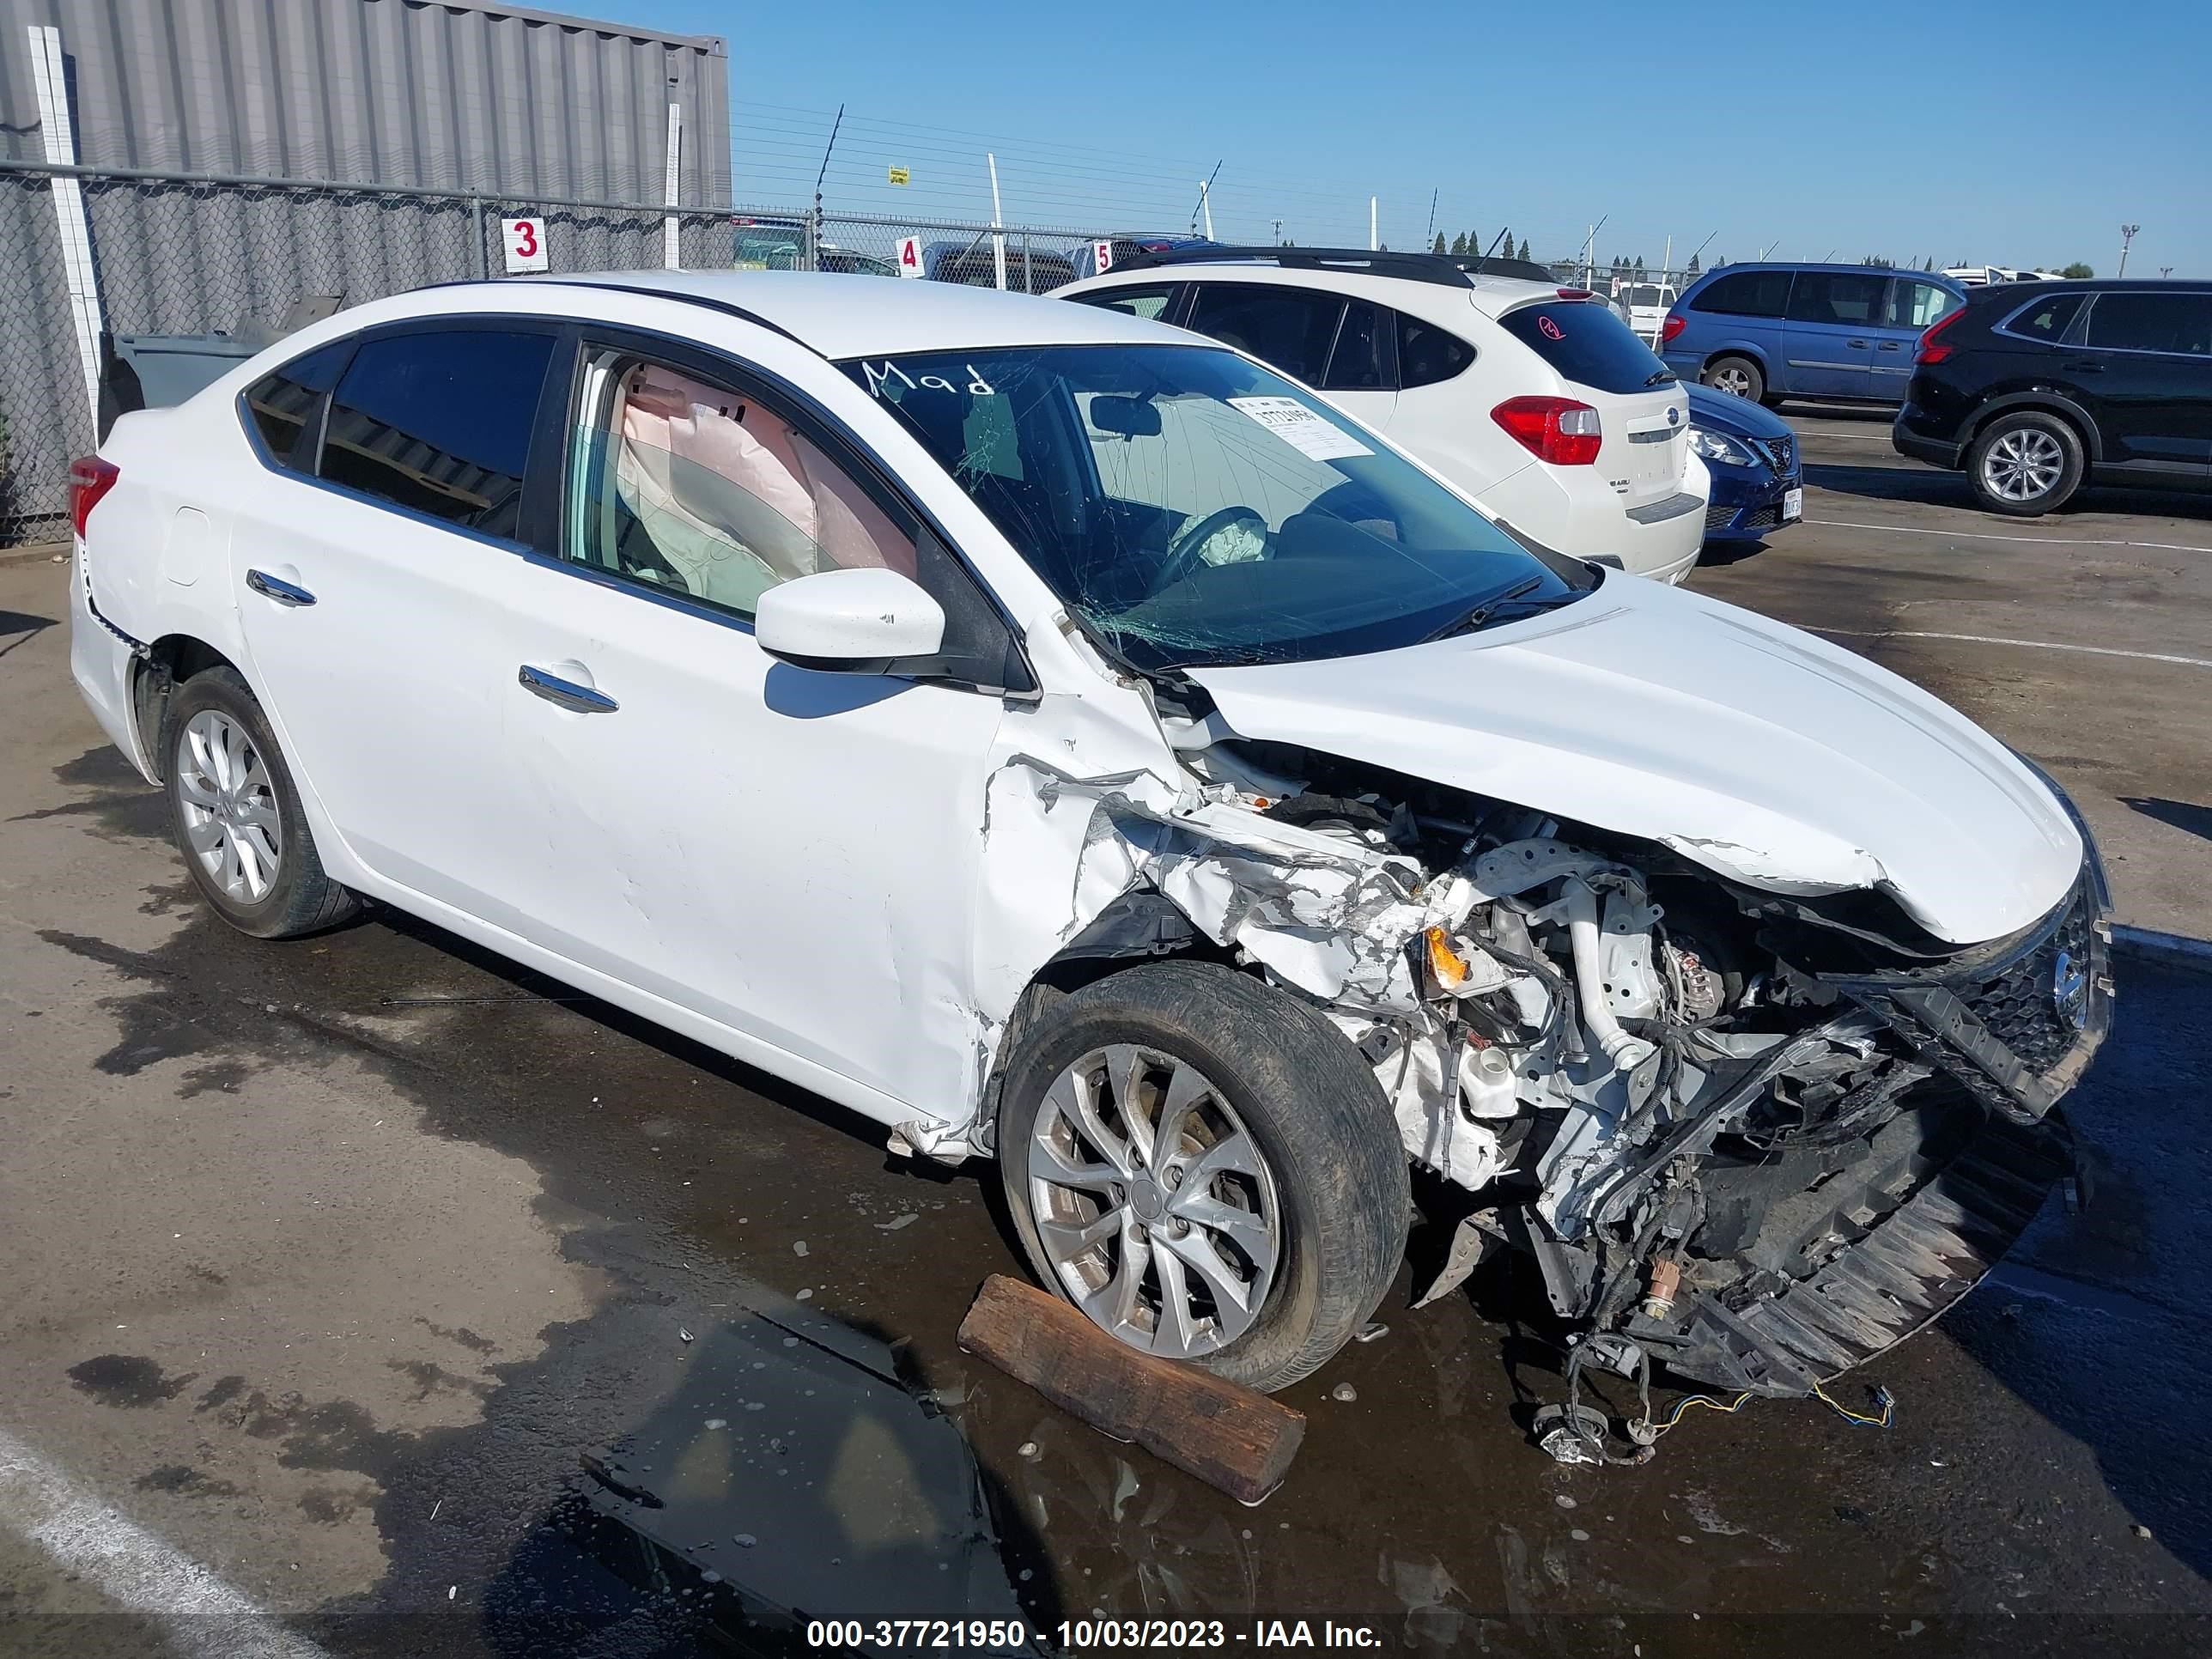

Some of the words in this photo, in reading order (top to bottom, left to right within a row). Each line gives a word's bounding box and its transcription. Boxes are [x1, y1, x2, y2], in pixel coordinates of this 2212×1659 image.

[514, 221, 538, 258] 3
[902, 240, 917, 268] 4
[1098, 245, 1109, 268] 5
